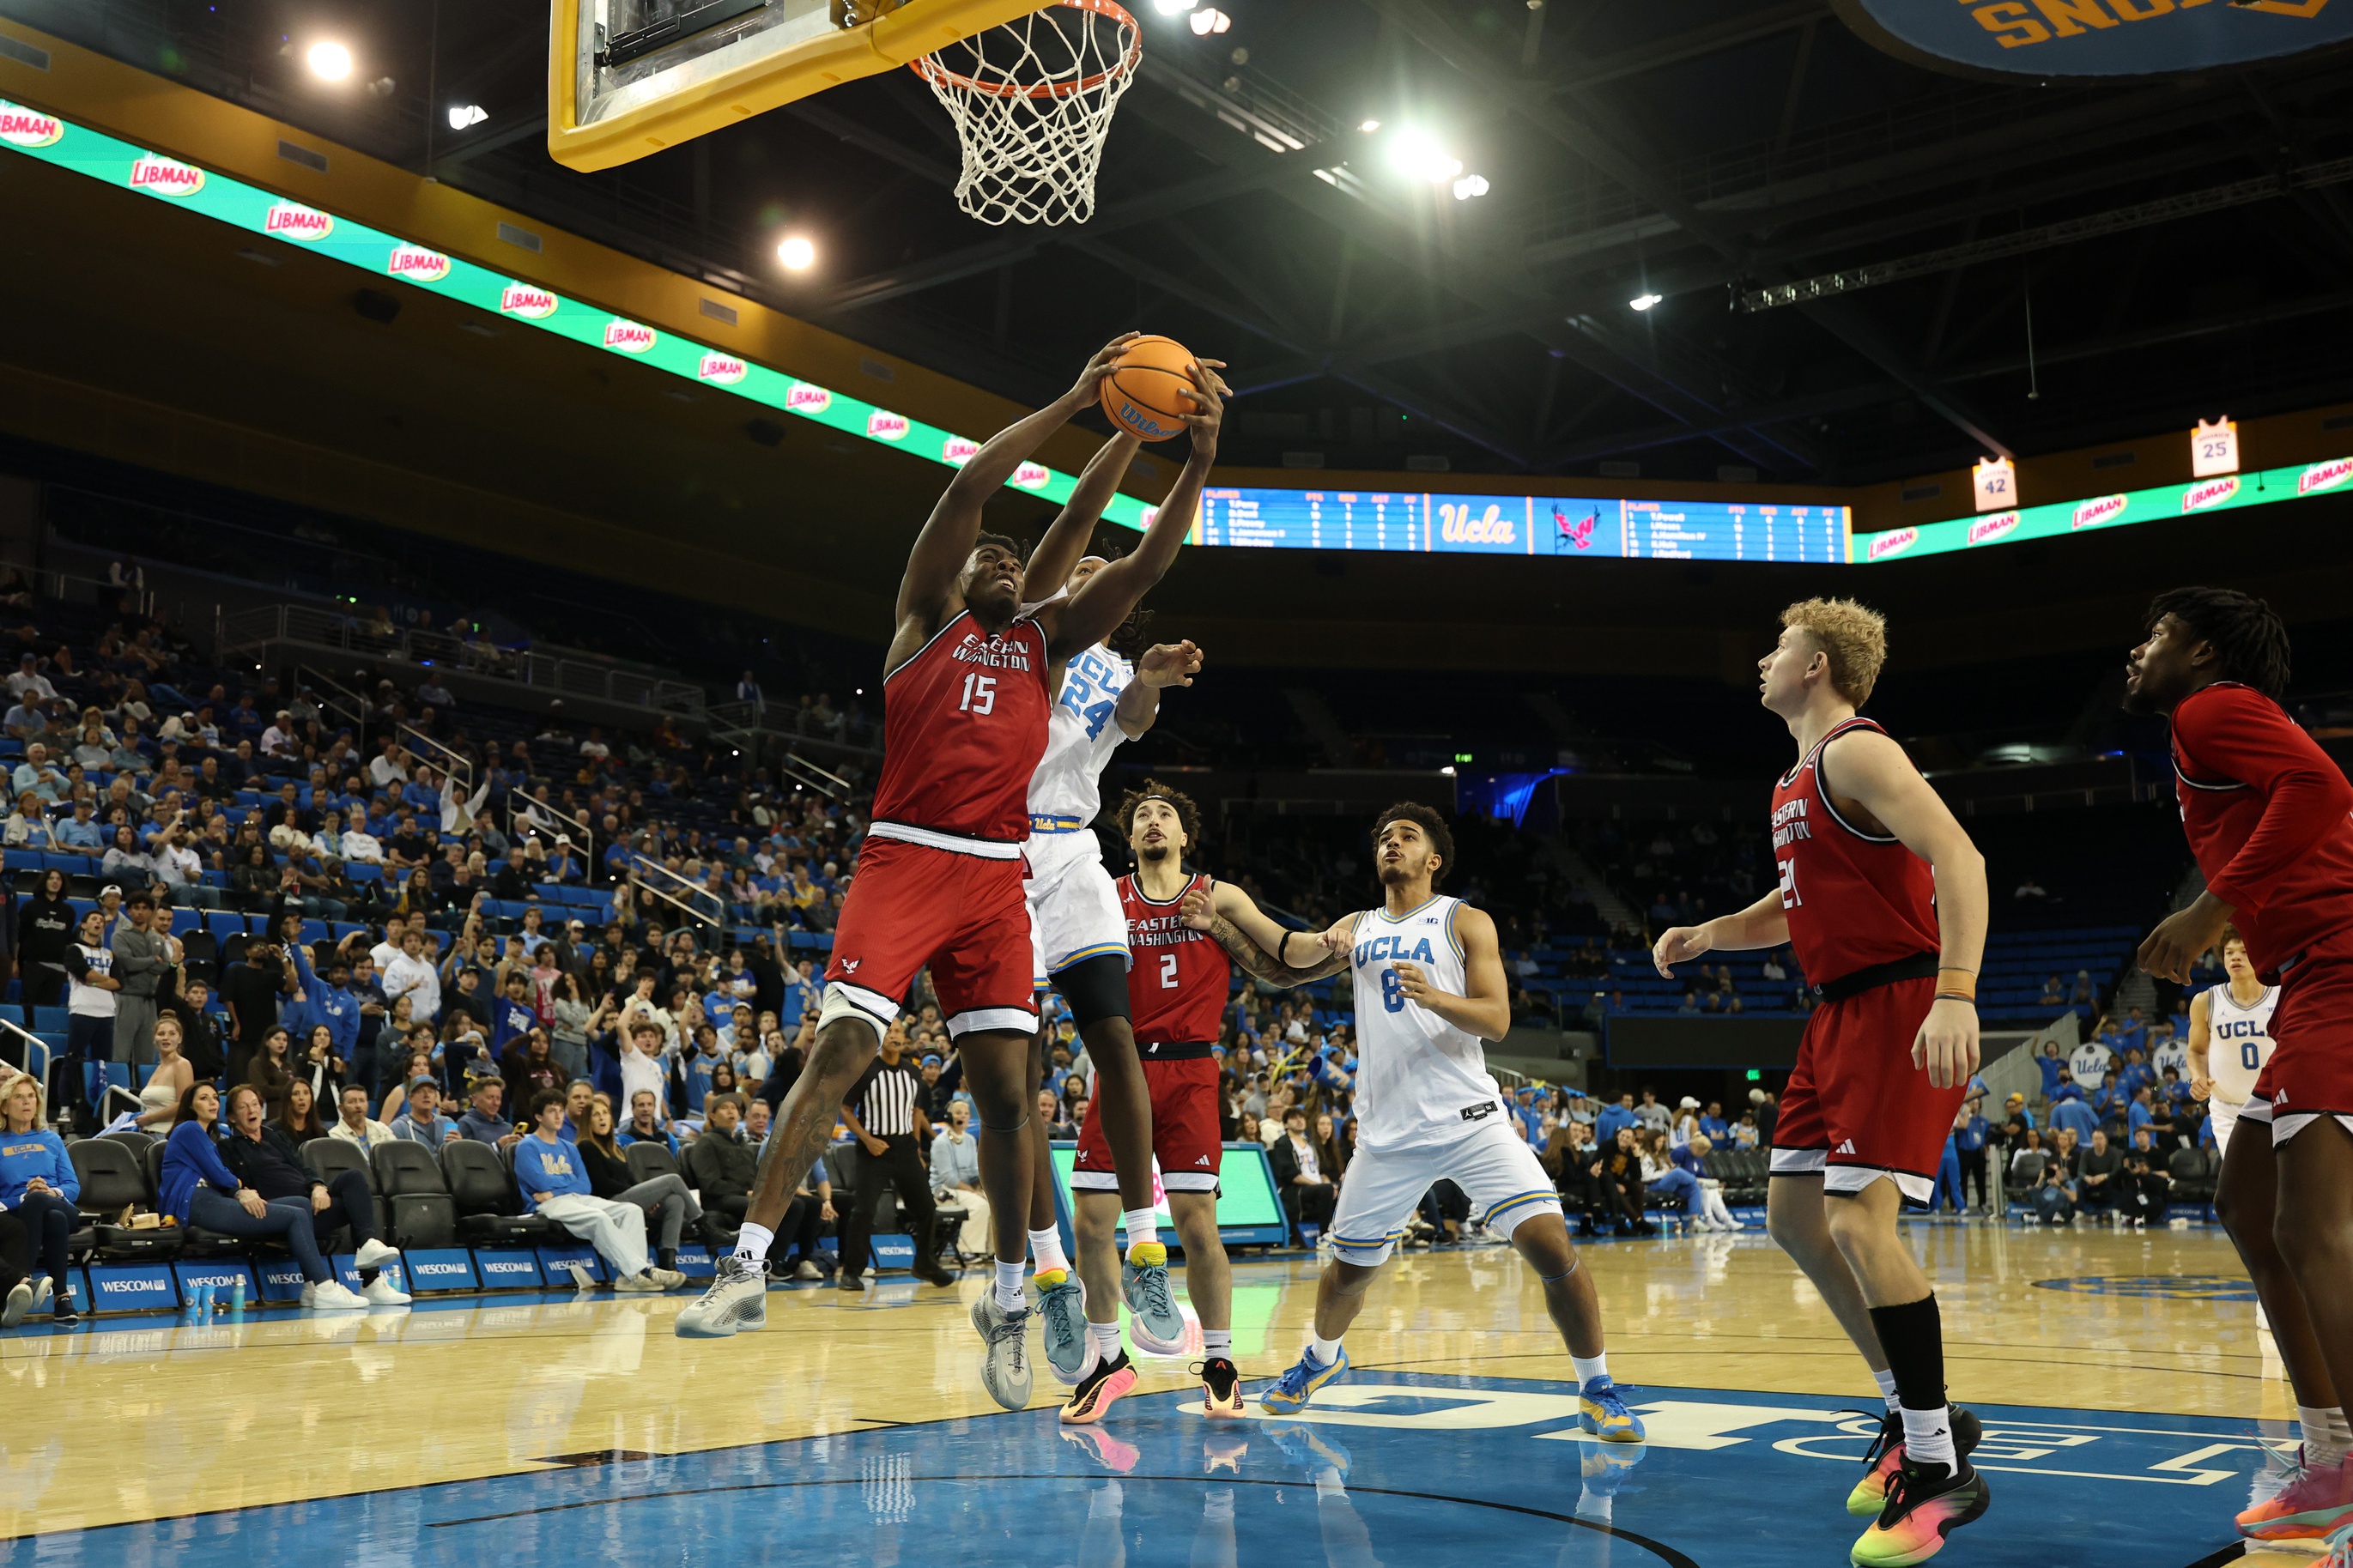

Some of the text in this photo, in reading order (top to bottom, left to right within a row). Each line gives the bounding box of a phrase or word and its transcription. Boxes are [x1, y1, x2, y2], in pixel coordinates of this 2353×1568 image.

[0, 114, 56, 136] BMAN
[131, 161, 198, 185] LIBMAN
[267, 209, 327, 231] LIBMAN
[390, 251, 445, 272] LIBMAN
[502, 290, 552, 310] LIBMAN
[605, 327, 652, 345] LIBMAN
[700, 360, 742, 377] LIBMAN
[787, 391, 826, 407] LIBMAN
[868, 419, 905, 433] LIBMAN
[1119, 402, 1181, 437] Wilson
[2204, 441, 2227, 458] 25
[1014, 469, 1046, 484] LIBMAN
[1986, 478, 2005, 494] 42
[2300, 460, 2353, 493] LIBMAN
[2183, 479, 2235, 512] LIBMAN
[2073, 497, 2121, 528] LIBMAN
[1439, 504, 1517, 544] Ucla
[1969, 515, 2015, 544] LIBMAN
[1870, 531, 1913, 558] LIBMAN
[1066, 651, 1124, 703] UCL
[959, 672, 998, 716] 15
[1059, 672, 1115, 743] 24
[1034, 817, 1056, 831] Ucla
[1778, 857, 1803, 910] 21
[1355, 935, 1435, 970] UCLA
[1160, 954, 1180, 990] 2
[1380, 968, 1405, 1014] 8
[2217, 1020, 2271, 1039] UCL
[2241, 1042, 2260, 1071] 0
[12, 1143, 37, 1153] UCLA
[267, 1273, 305, 1284] WESCO
[415, 1262, 458, 1274] WESCOM
[483, 1262, 525, 1273] WESCOM
[101, 1280, 154, 1293] WESCOM
